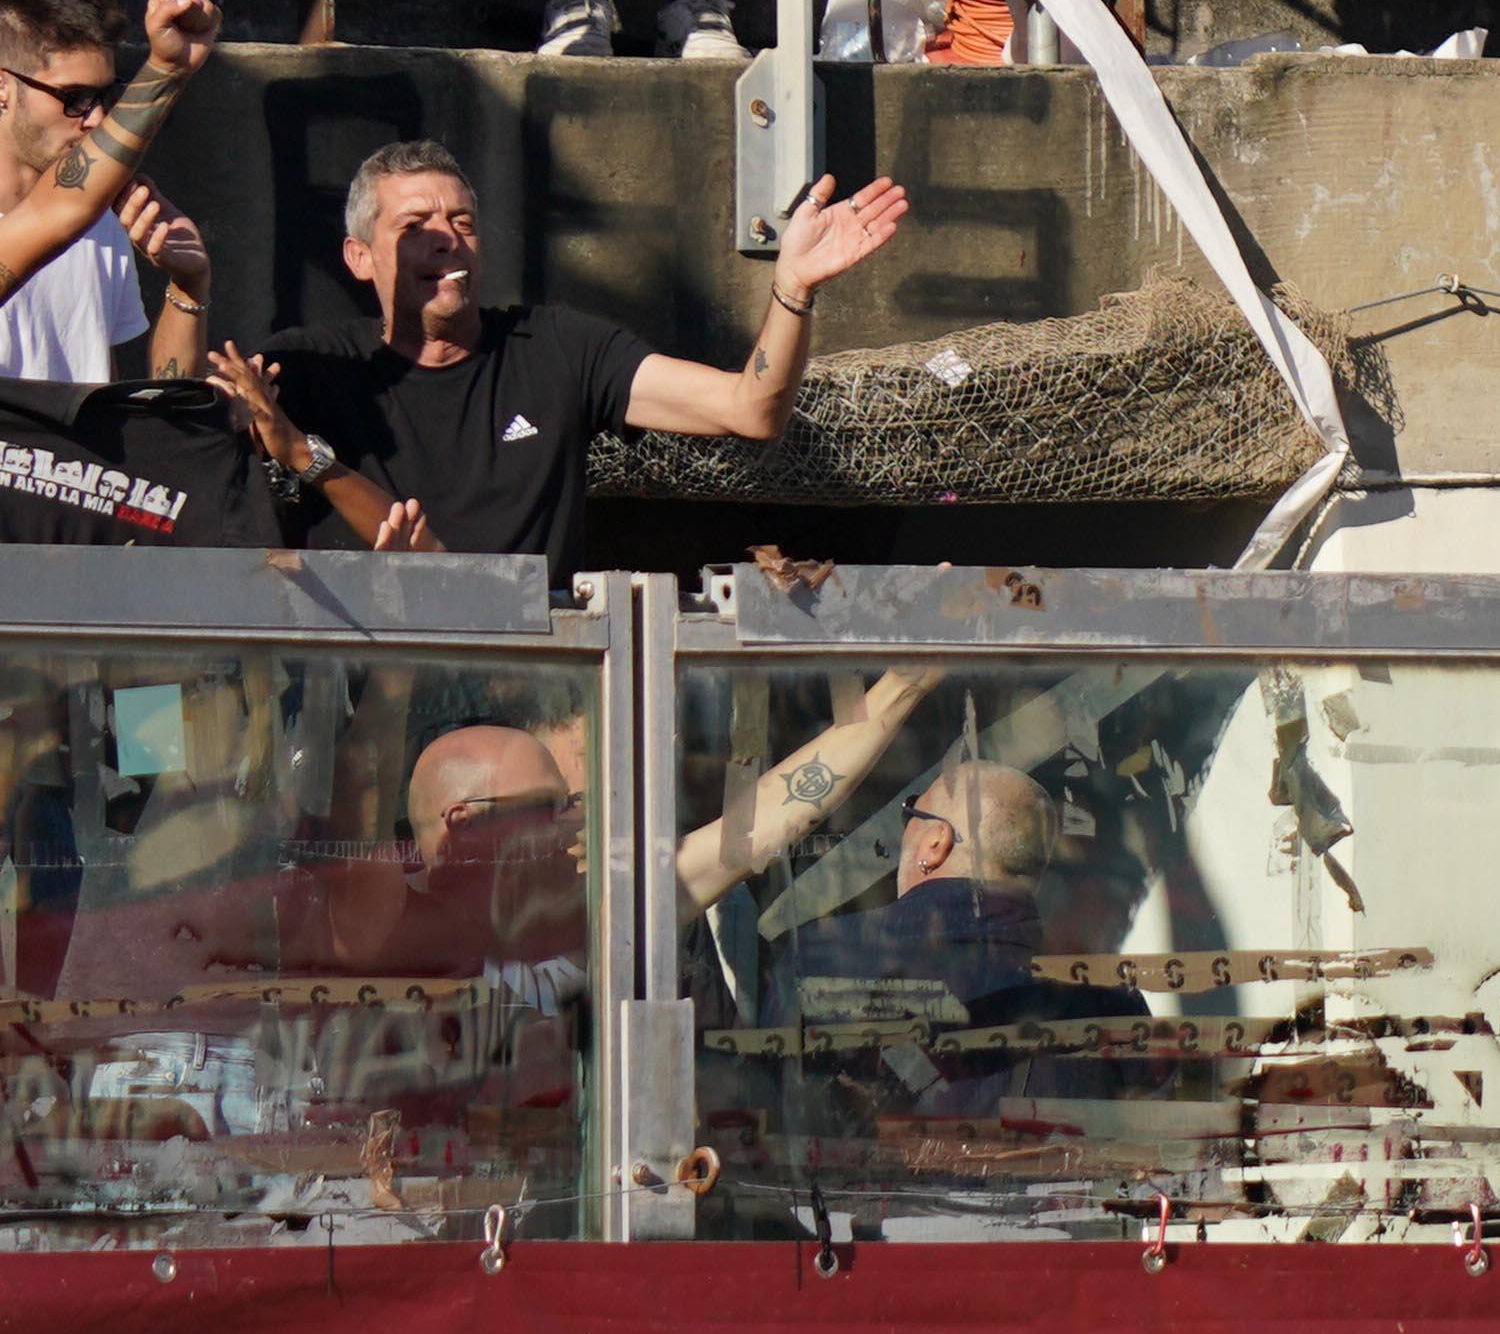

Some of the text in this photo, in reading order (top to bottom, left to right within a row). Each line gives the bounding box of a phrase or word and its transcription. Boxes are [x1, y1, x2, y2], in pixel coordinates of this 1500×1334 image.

[14, 474, 58, 499] ALTO
[58, 486, 81, 506] LA
[82, 493, 114, 516] MIA
